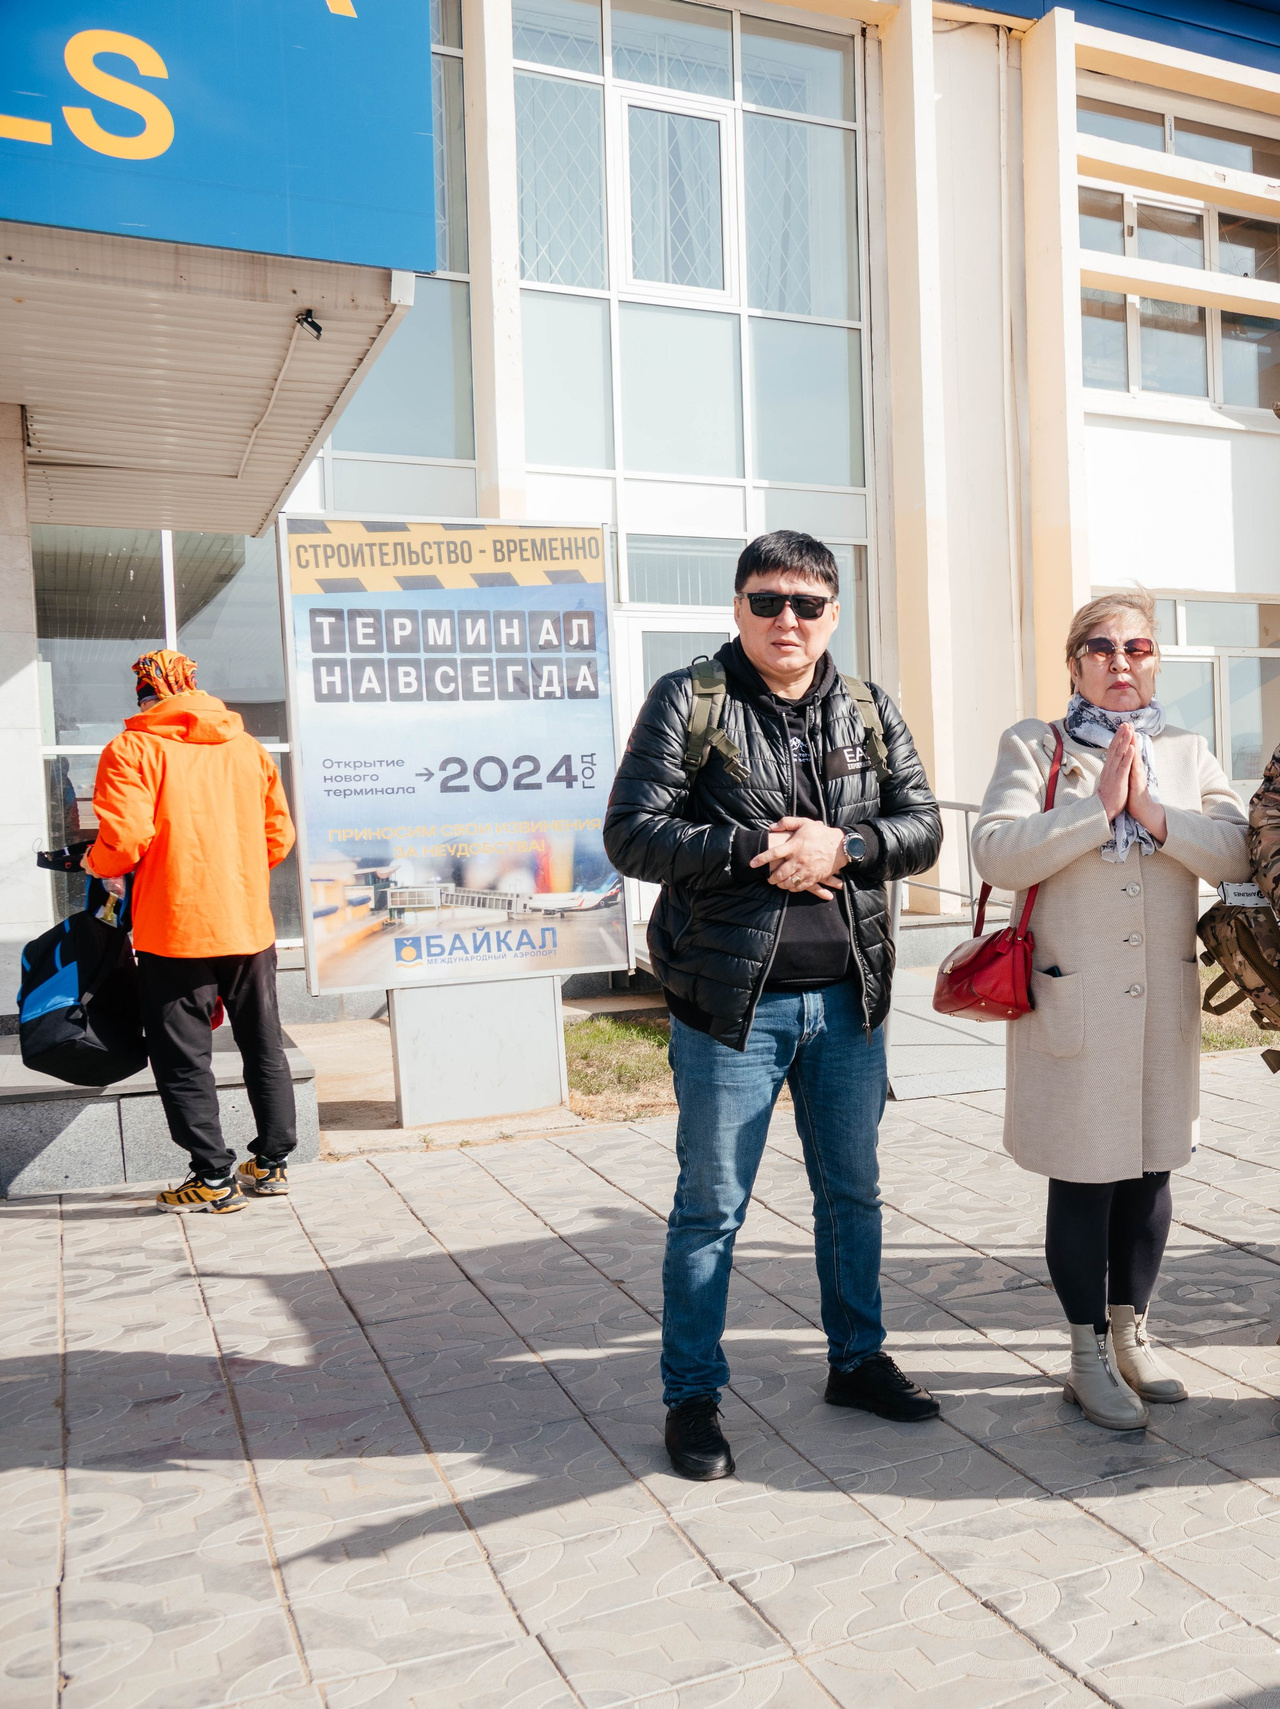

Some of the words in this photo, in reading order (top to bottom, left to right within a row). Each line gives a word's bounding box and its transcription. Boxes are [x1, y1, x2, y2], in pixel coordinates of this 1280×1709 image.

[296, 540, 473, 569] СТРОИТЕЛЬСТВО
[492, 536, 600, 563] ВРЕМЕННО
[314, 617, 590, 646] ТЕРМИНАЛ
[320, 665, 596, 698] НАВСЕГДА
[322, 757, 405, 771] Открытие
[438, 754, 579, 793] 2024
[323, 773, 380, 783] нового
[324, 785, 416, 799] терминала
[328, 825, 438, 843] ПРИНОСИМ
[441, 822, 493, 838] СВОИ
[495, 818, 602, 835] ИЗВИНЕНИЯ
[393, 846, 419, 859] ЗА
[422, 839, 546, 858] НЕУДОБСТВА!
[425, 926, 559, 958] БАЙКАЛ
[427, 952, 508, 965] МЕЖДУНАРОДНЫЙ
[513, 949, 558, 959] АЭРОПОРТ
